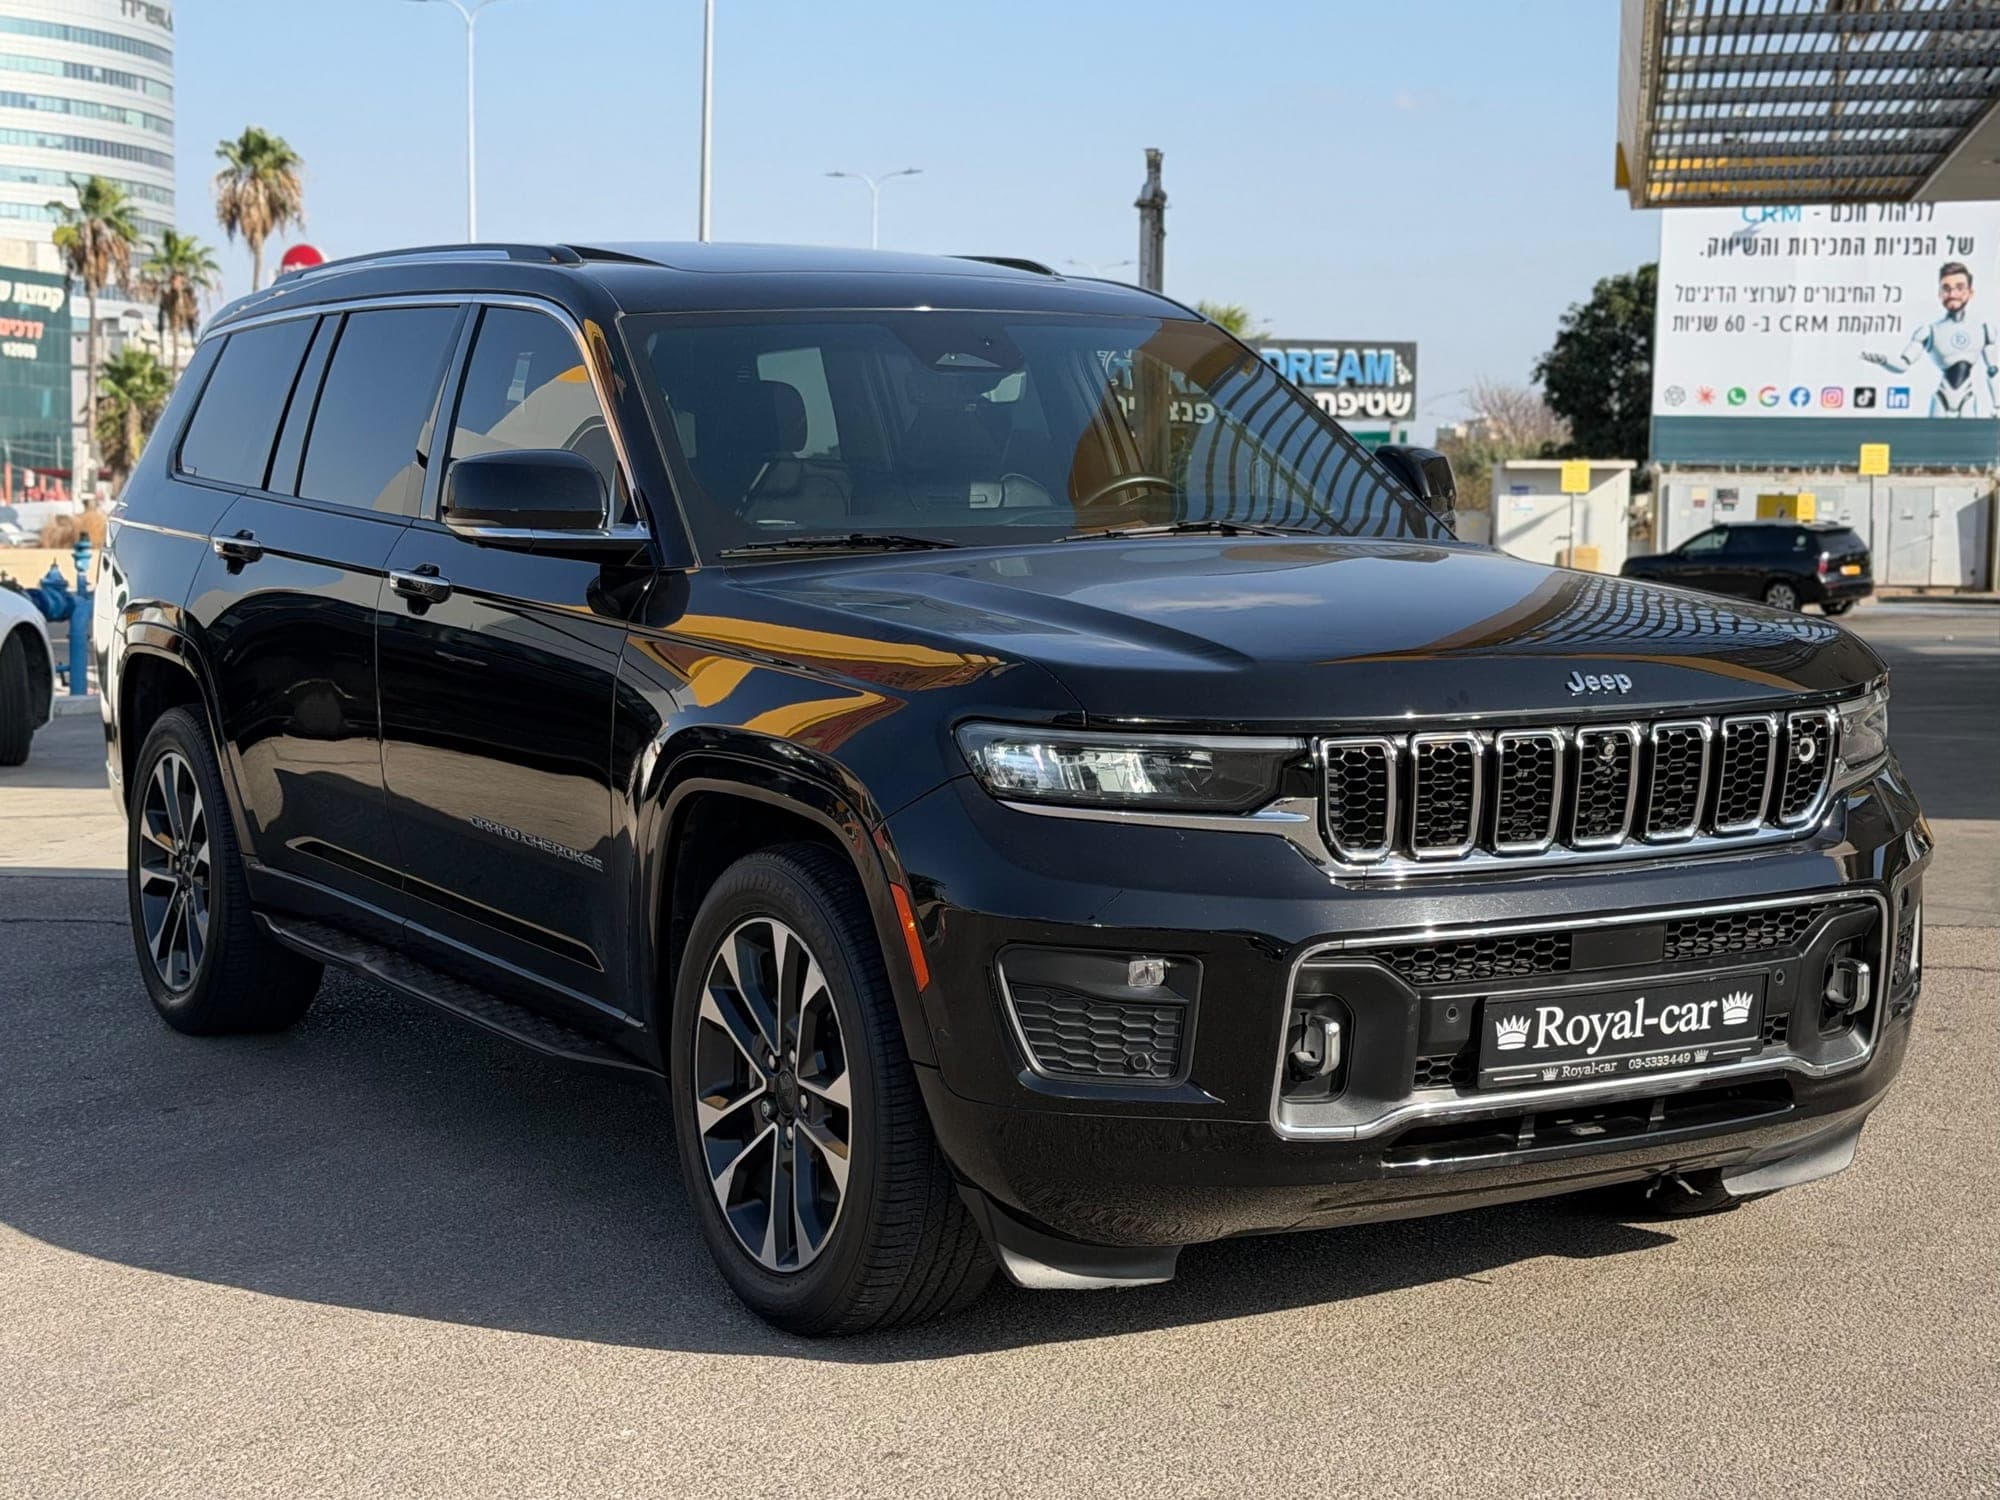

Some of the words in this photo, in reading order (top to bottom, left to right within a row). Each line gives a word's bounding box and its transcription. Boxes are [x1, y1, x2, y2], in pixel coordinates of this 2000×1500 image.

[1741, 204, 1802, 223] CRM
[1830, 202, 1867, 222] חכם
[1876, 201, 1936, 222] לניהול
[1788, 237, 1866, 256] המכירות
[1874, 236, 1937, 256] הפניות
[1946, 234, 1975, 256] של
[1675, 284, 1736, 303] הדיגיטל
[1743, 284, 1797, 303] לערוצי
[1804, 285, 1875, 303] החיבורים
[1881, 284, 1902, 303] כל
[1672, 315, 1718, 333] שניות
[1724, 314, 1745, 333] 60
[1779, 315, 1828, 333] CRM
[1837, 314, 1902, 335] ולהקמת
[1259, 347, 1396, 388] DREAM
[1313, 391, 1413, 417] שטיפת
[1565, 671, 1633, 695] Jeep
[469, 815, 519, 842] GRAND
[521, 832, 604, 873] CHEROKEE
[1532, 997, 1718, 1055] Royal-car
[1561, 1061, 1618, 1078] Royal-car
